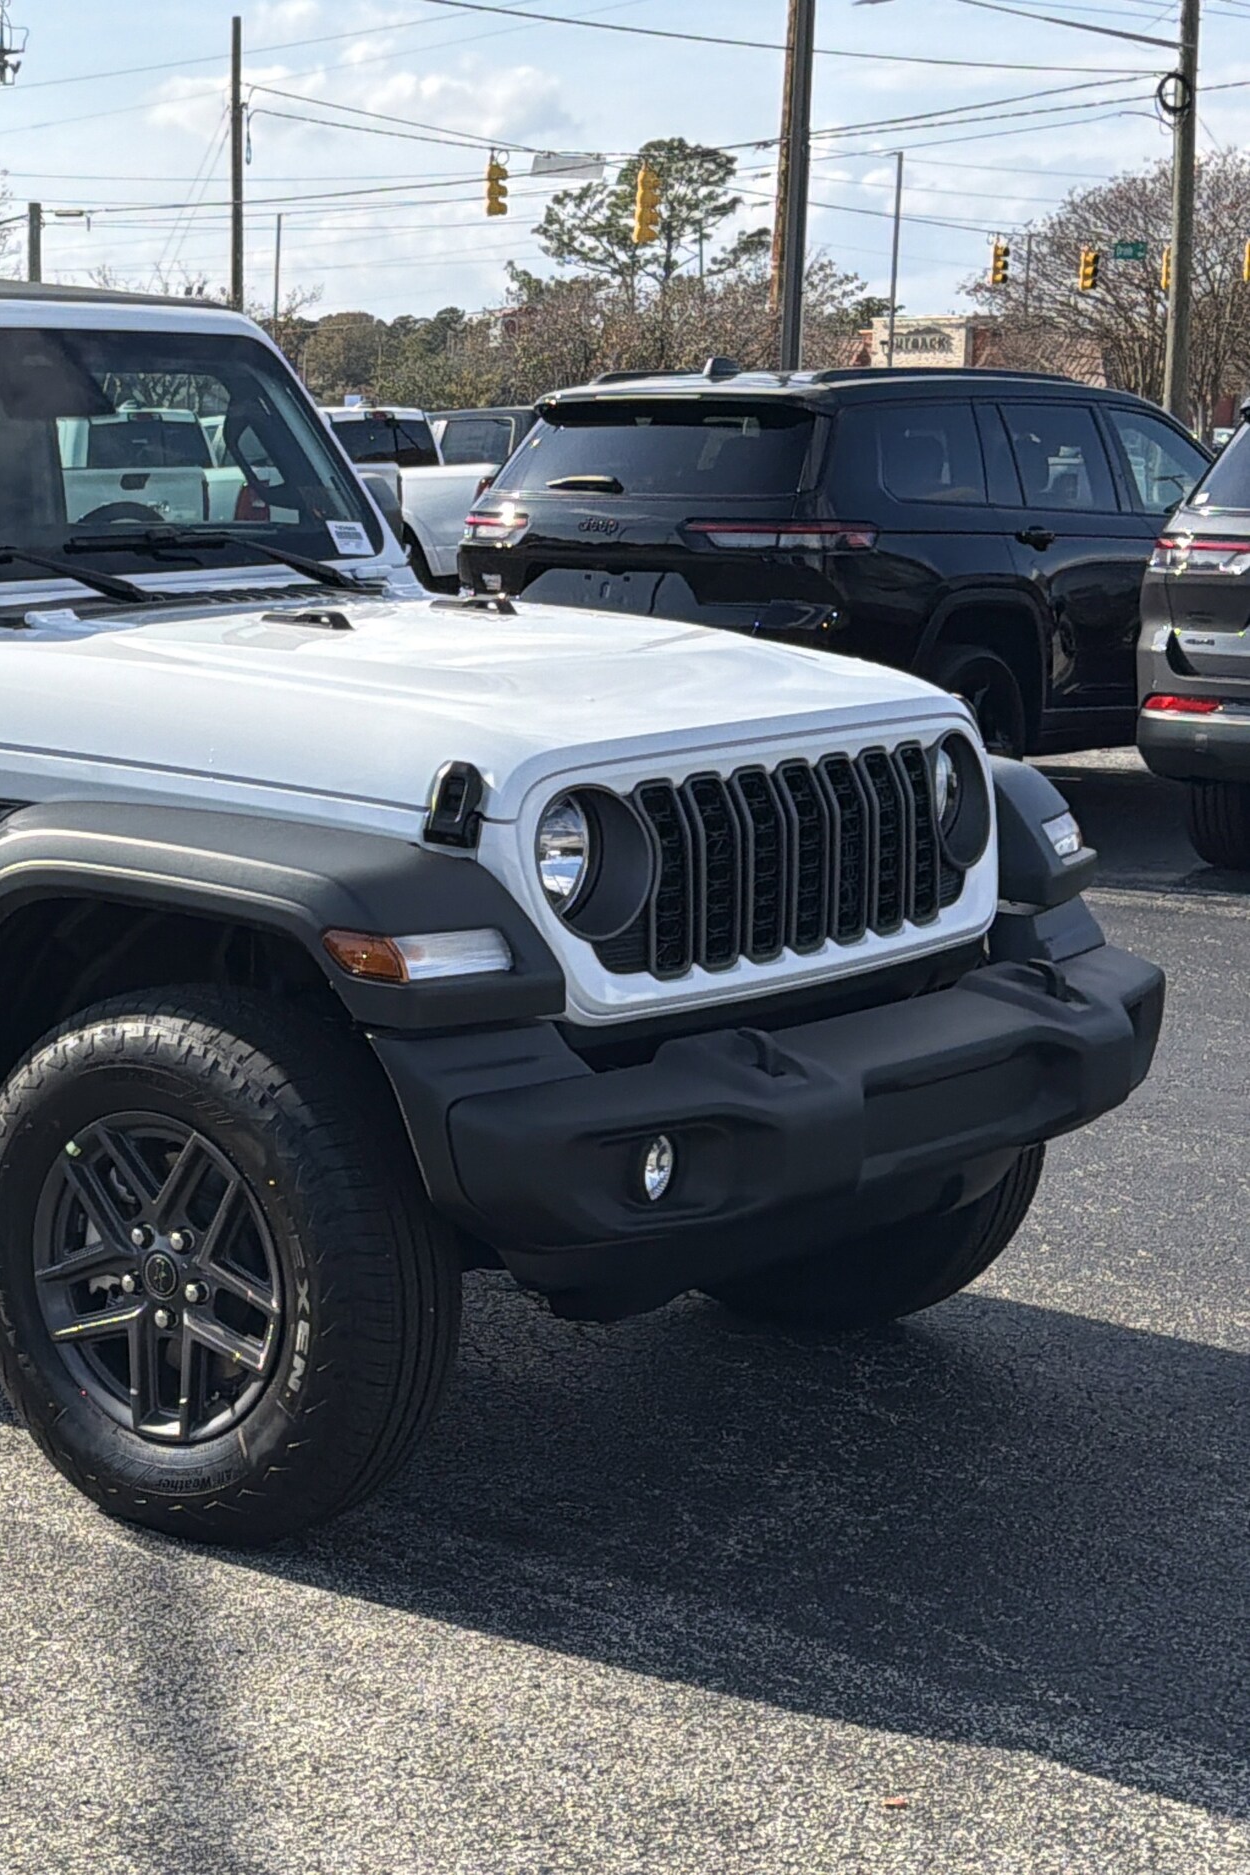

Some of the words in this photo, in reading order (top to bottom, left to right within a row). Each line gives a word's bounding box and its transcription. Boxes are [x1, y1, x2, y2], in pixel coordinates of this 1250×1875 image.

[889, 336, 947, 351] UTBACK
[578, 518, 619, 536] Jeep
[156, 1476, 212, 1493] Weather
